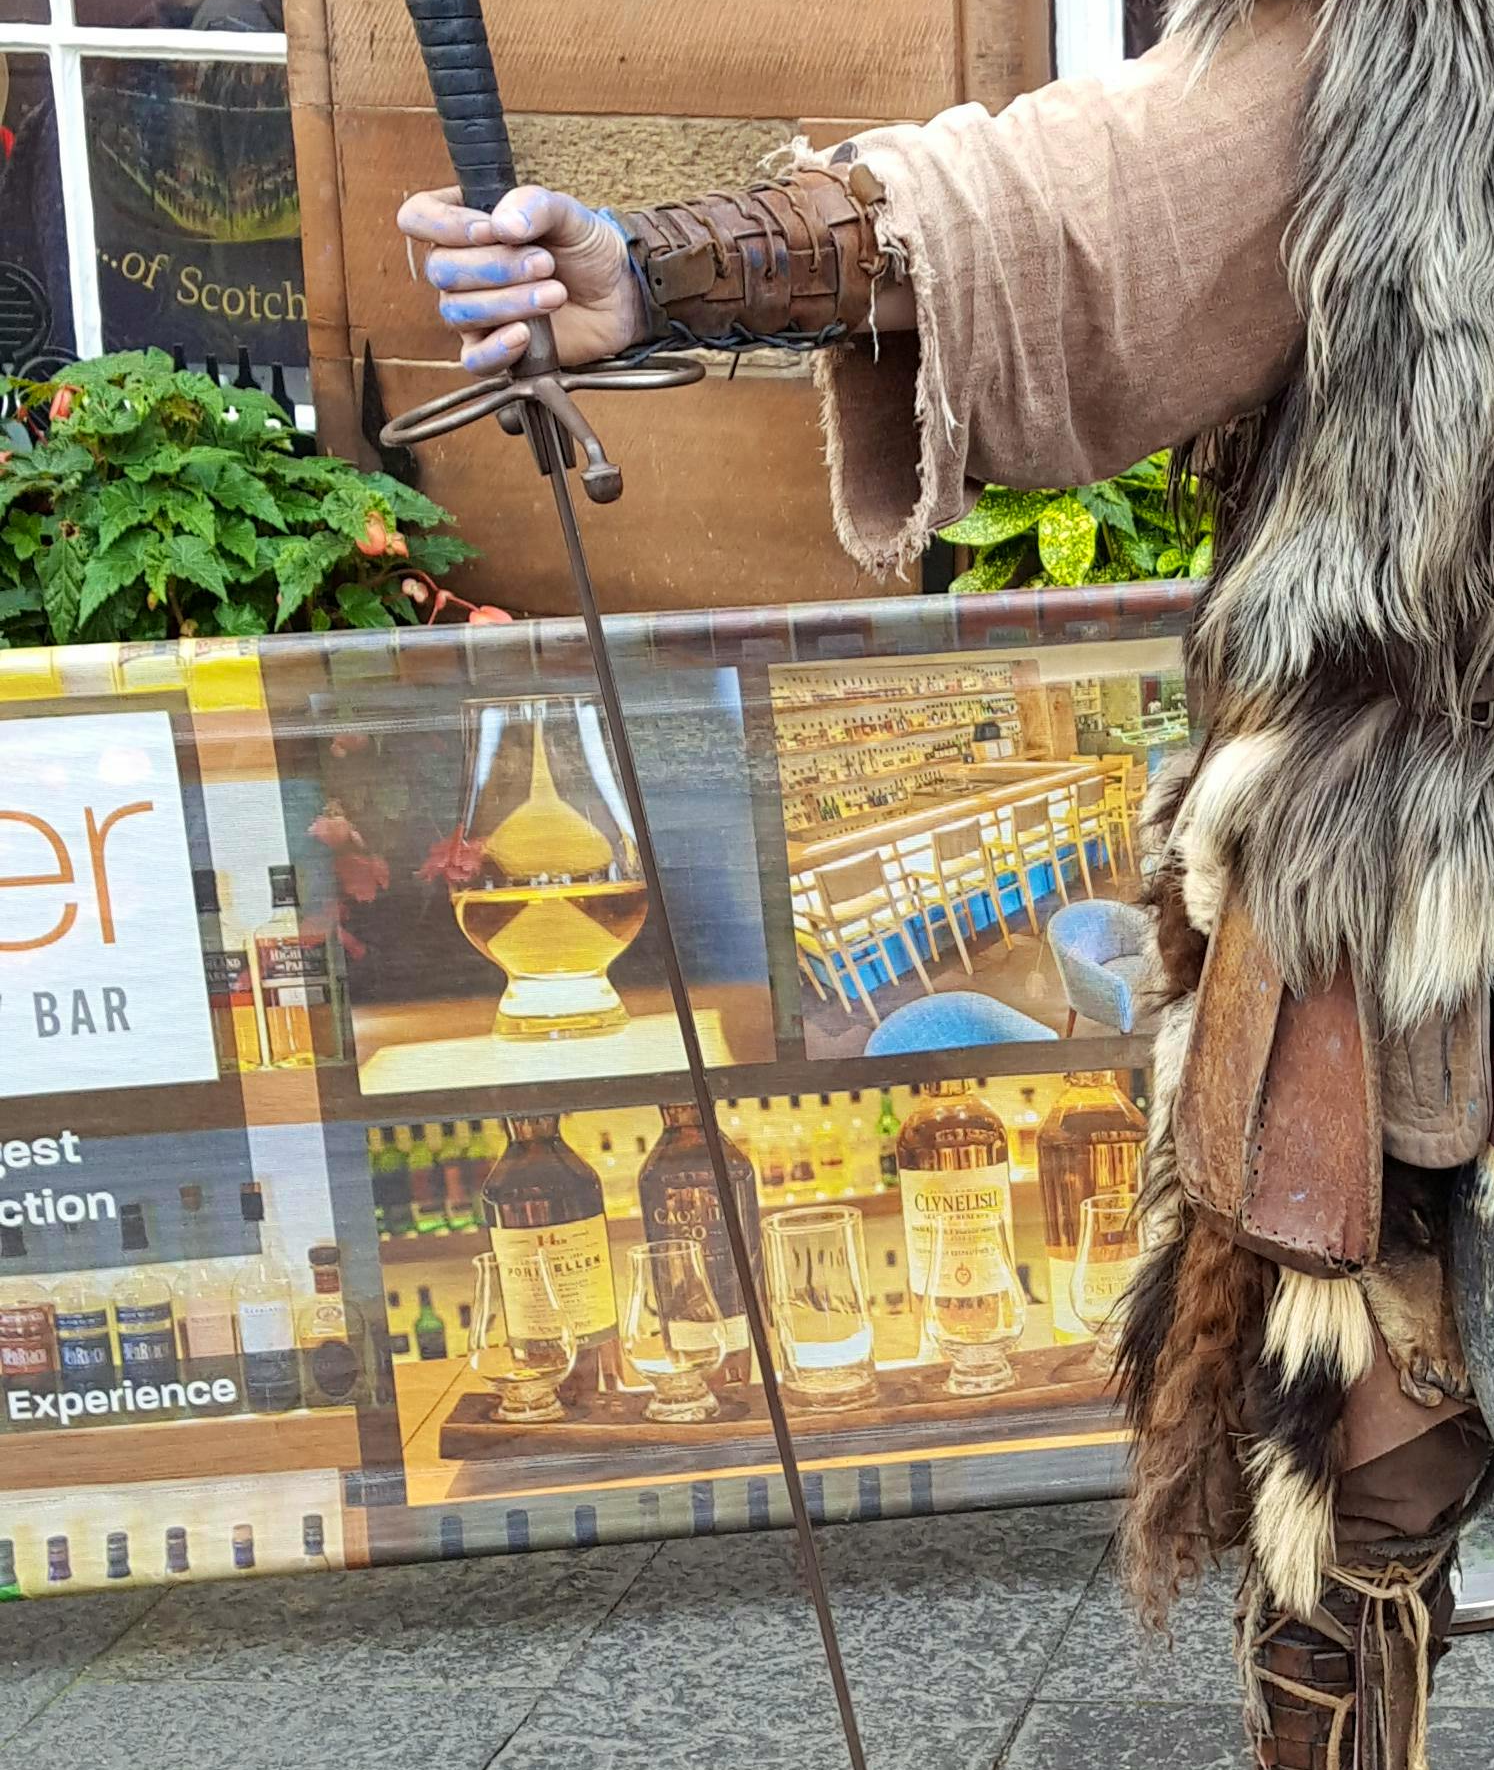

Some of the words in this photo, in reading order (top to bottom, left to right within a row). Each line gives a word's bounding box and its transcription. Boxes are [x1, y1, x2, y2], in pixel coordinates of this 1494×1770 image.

[175, 265, 309, 322] Scotch
[32, 986, 132, 1038] BAR
[0, 1189, 118, 1228] ction
[914, 1190, 998, 1213] CLYNELISH
[553, 1253, 602, 1273] ELLEN
[7, 1379, 238, 1426] Experience
